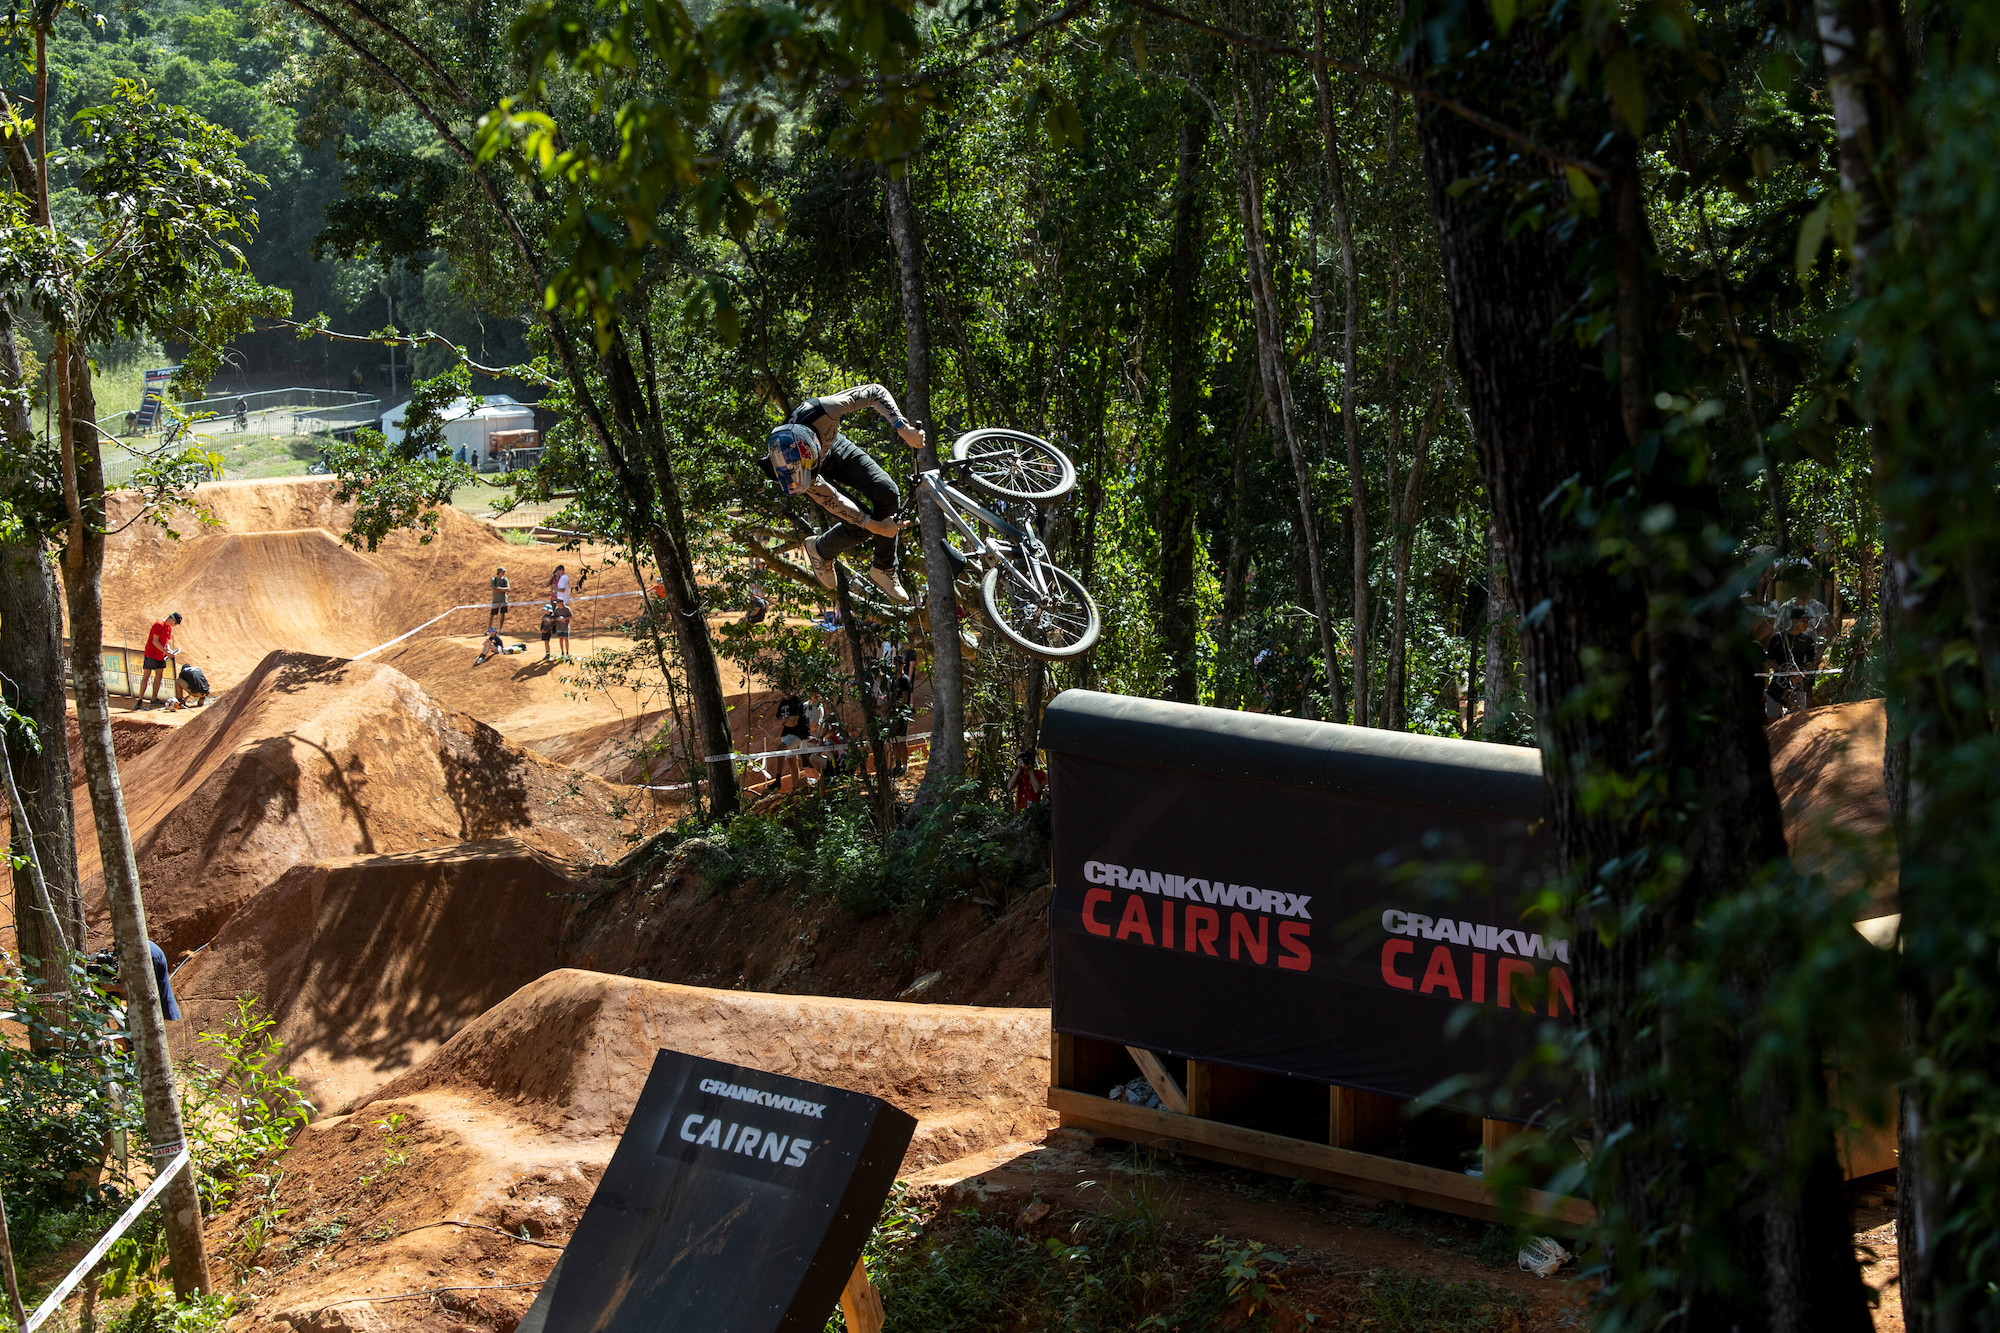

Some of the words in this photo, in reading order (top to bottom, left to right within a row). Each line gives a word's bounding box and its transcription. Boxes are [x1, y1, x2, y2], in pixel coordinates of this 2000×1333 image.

[1084, 861, 1312, 919] CRANKWORX
[1082, 888, 1312, 972] CAIRNS
[699, 1078, 827, 1119] CRANKWORX
[153, 1144, 183, 1156] CAIRNS
[680, 1114, 812, 1167] CAIRNS
